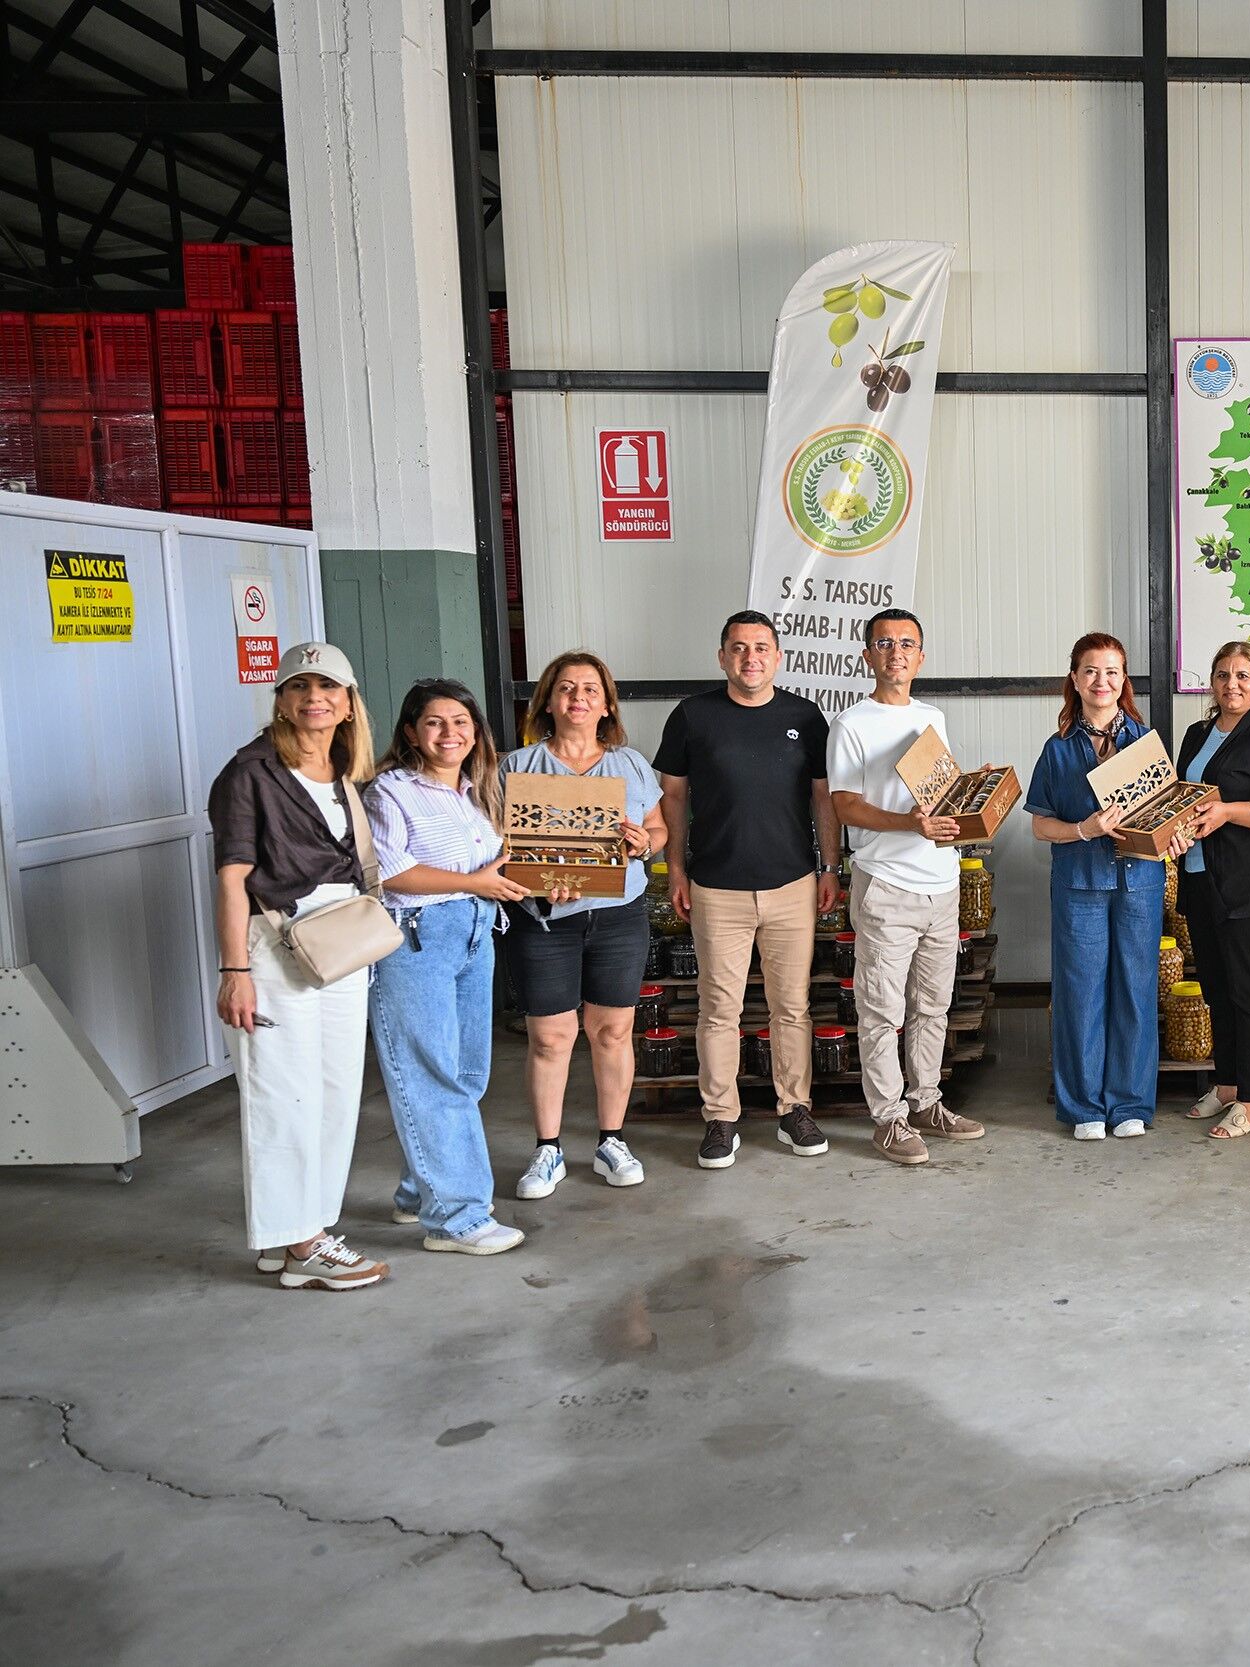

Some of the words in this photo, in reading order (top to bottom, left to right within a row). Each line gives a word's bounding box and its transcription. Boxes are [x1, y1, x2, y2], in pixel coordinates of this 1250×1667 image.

[1186, 488, 1220, 496] Çanakkale
[617, 508, 656, 518] YANGIN
[605, 520, 669, 532] SÖNDÜRÜCÜ
[69, 554, 125, 579] DİKKAT
[74, 587, 82, 598] BU
[82, 585, 97, 599] TESİS
[97, 588, 113, 599] 7/24
[825, 579, 893, 608] TARSUS
[59, 605, 81, 617] KAMERA
[81, 603, 90, 618] İLE
[90, 603, 123, 618] İZLENMEKTE
[123, 607, 132, 618] VE
[57, 624, 74, 636] KAYIT
[75, 624, 92, 636] ALTINA
[93, 624, 132, 636] ALINMAKTADIR
[772, 612, 843, 640] ESHAB-I
[245, 639, 274, 652] SİGARA
[248, 653, 272, 669] İÇMEK
